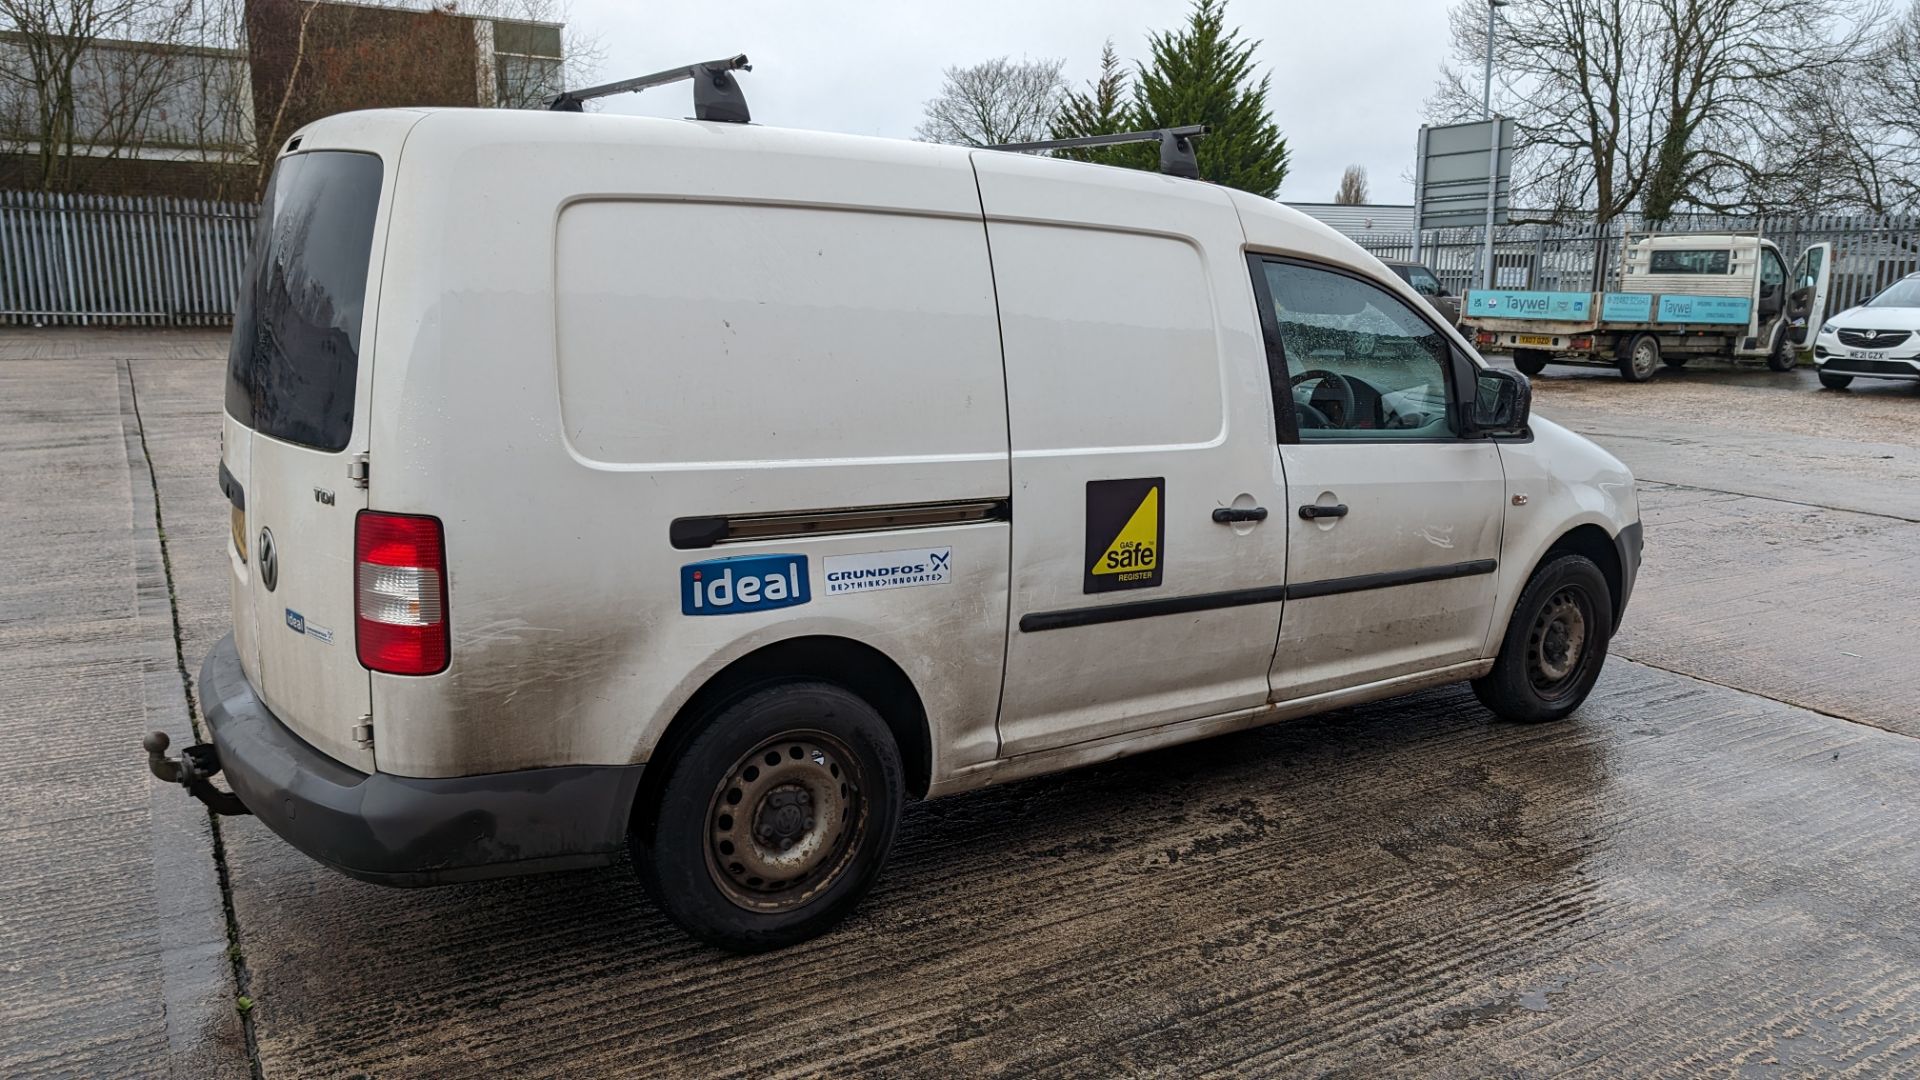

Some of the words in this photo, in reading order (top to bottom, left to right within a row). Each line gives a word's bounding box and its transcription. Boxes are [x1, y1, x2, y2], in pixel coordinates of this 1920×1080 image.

[1505, 295, 1550, 312] Taywel
[1664, 299, 1692, 315] Taywel
[313, 487, 336, 507] TDI
[1119, 541, 1134, 549] GAS
[1106, 543, 1154, 569] safe
[827, 564, 925, 581] GRUNDFOS
[1118, 571, 1152, 582] REGISTER
[692, 562, 801, 608] ideal
[287, 612, 304, 632] ideal
